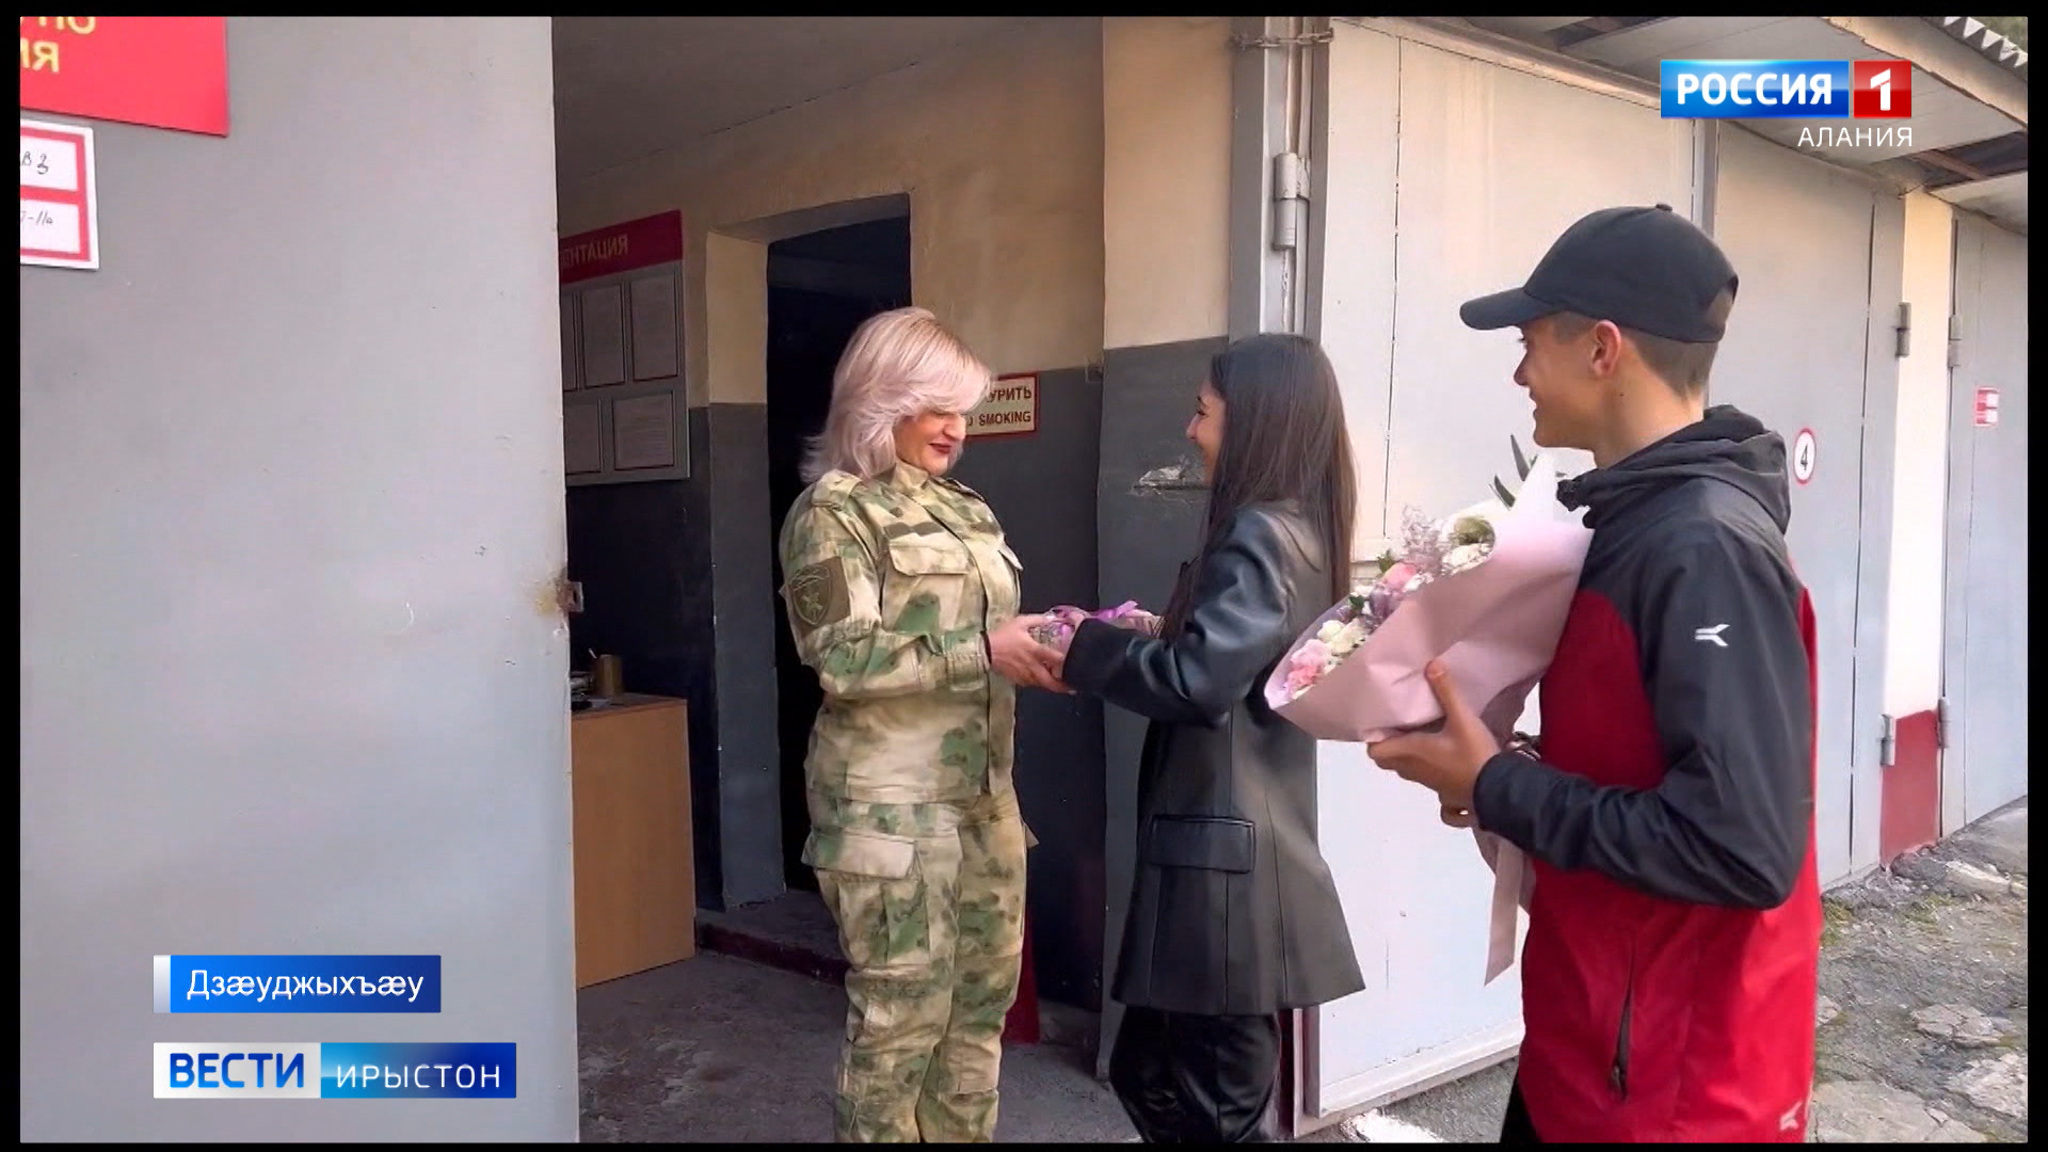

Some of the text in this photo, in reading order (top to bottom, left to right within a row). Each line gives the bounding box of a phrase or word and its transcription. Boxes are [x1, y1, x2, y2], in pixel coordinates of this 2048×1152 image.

[986, 385, 1032, 403] УРИТЬ
[979, 411, 1031, 427] SMOKING
[1800, 445, 1808, 470] 4
